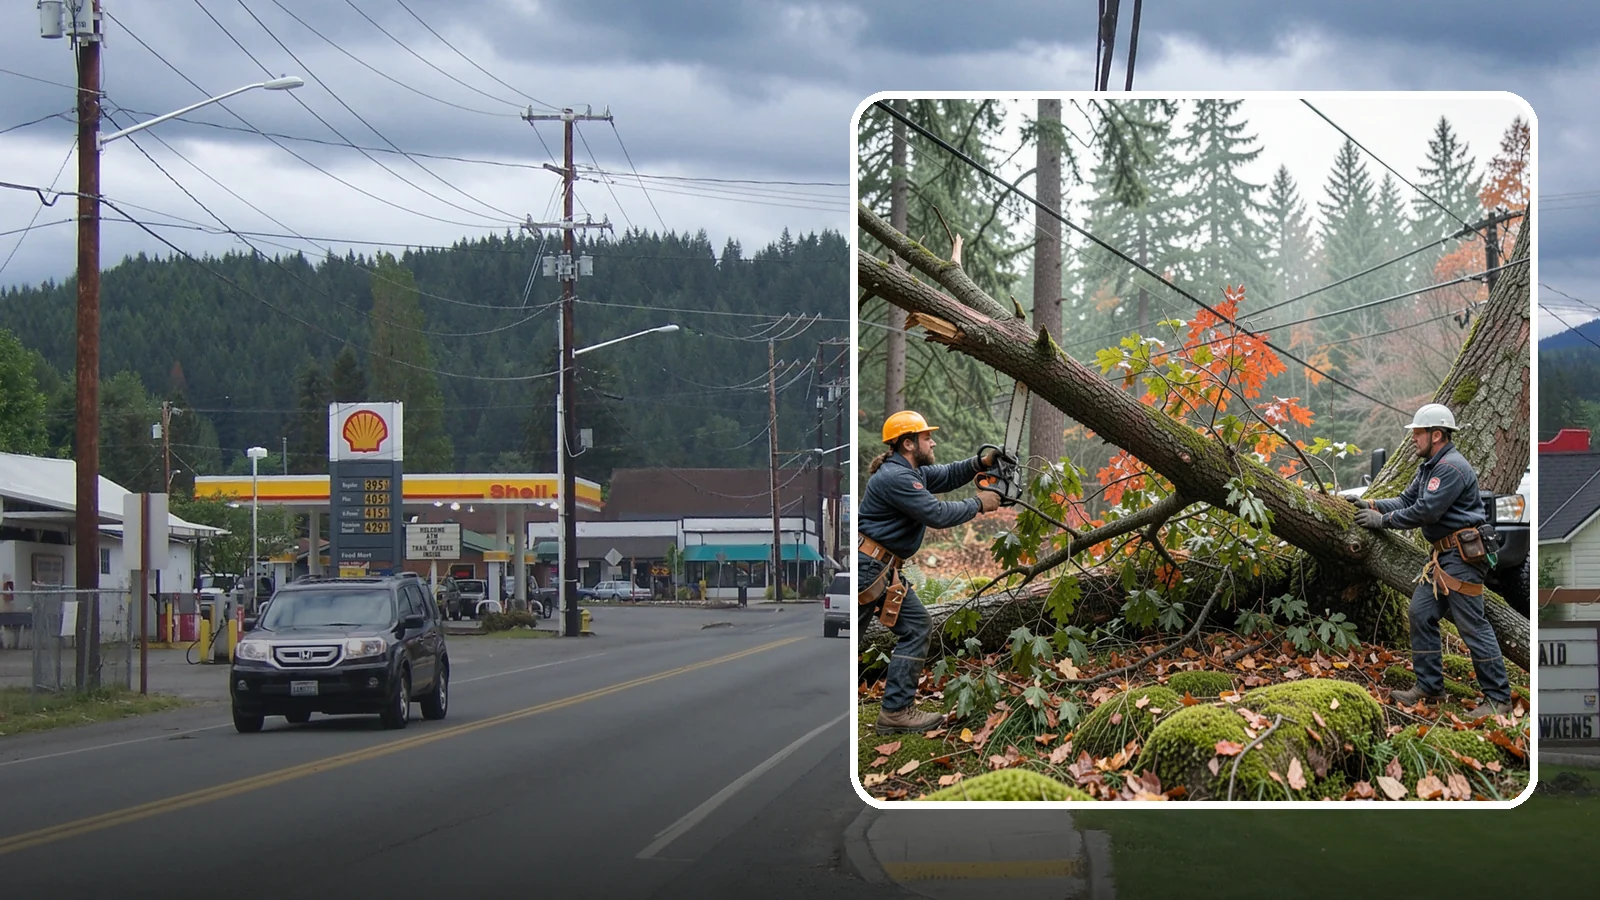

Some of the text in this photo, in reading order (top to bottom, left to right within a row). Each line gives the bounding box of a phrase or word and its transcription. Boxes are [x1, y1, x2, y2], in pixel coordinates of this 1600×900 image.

[366, 480, 383, 490] 395
[490, 484, 547, 499] Shell
[366, 494, 383, 504] 405
[366, 508, 383, 518] 415
[366, 522, 383, 532] 429
[1538, 643, 1566, 665] AID
